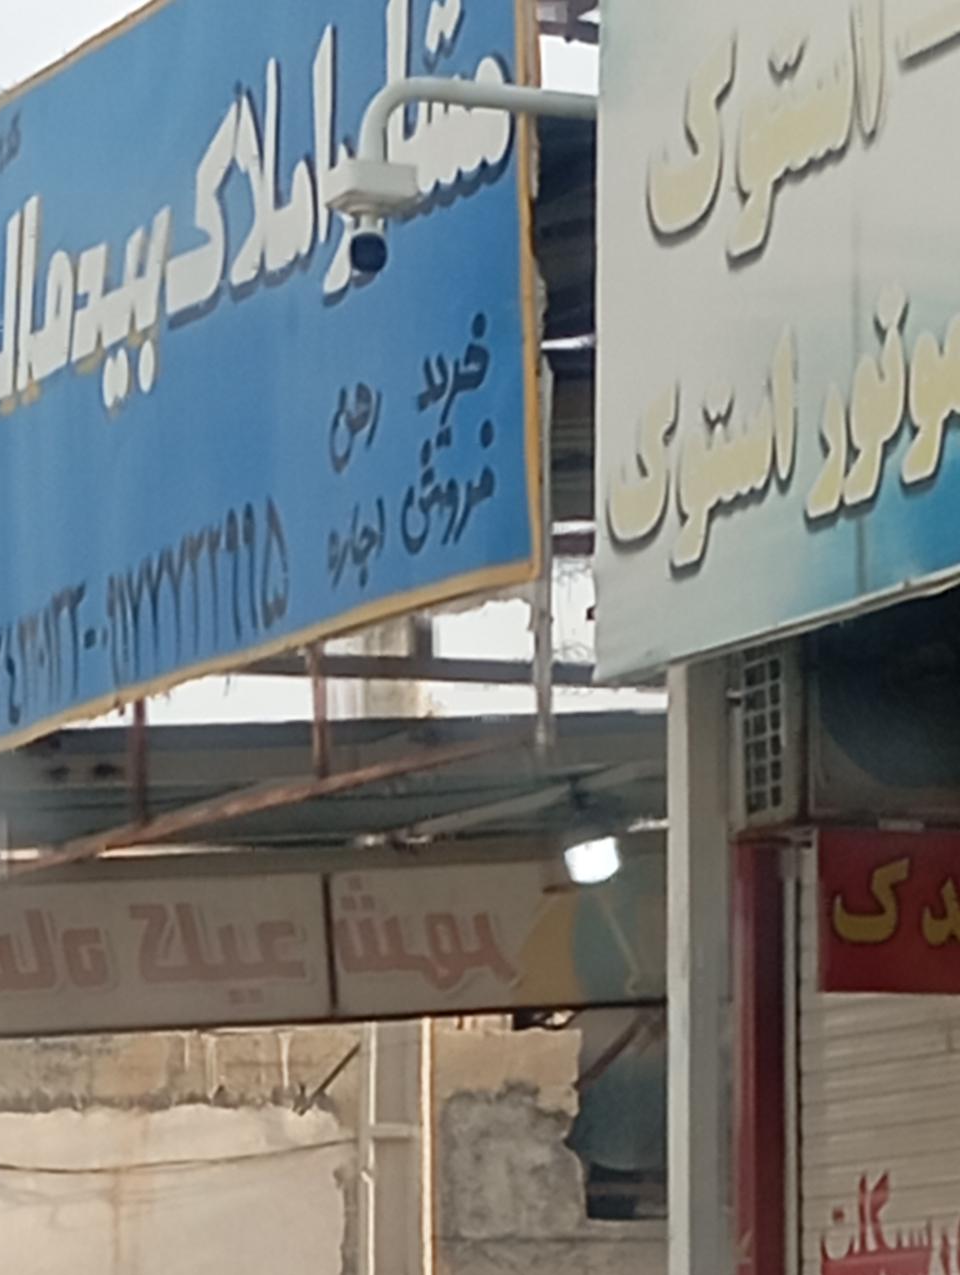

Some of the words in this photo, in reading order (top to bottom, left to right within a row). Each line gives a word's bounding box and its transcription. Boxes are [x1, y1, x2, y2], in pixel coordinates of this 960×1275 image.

[417, 312, 490, 448] خرید
[328, 498, 386, 588] اجاره
[401, 420, 496, 555] فروش
